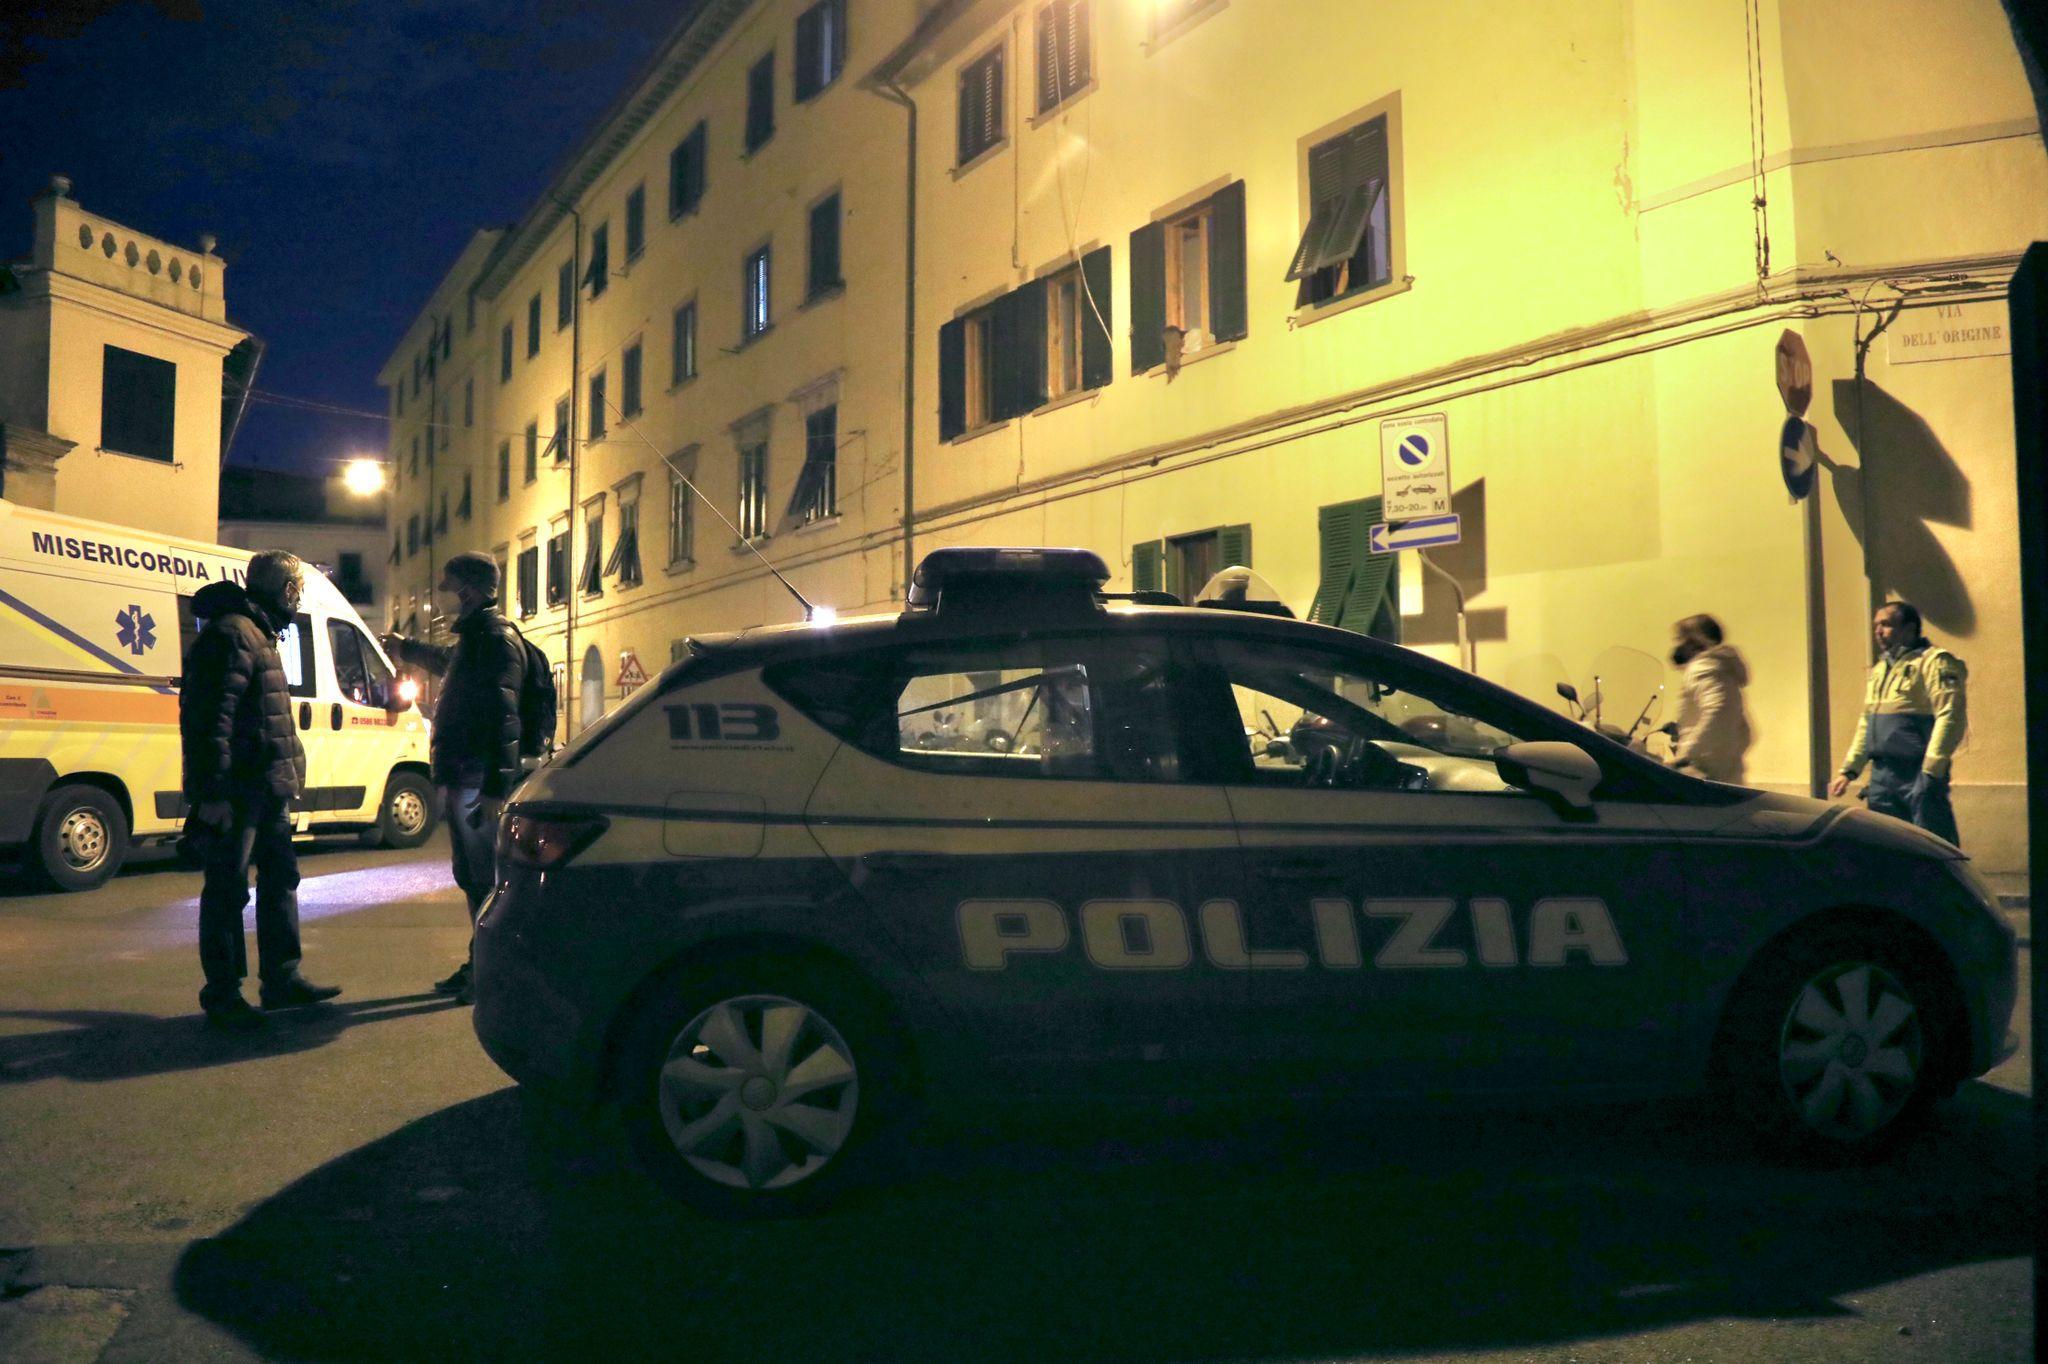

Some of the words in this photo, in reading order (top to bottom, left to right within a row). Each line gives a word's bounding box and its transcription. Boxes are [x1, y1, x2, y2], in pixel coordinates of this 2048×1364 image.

[1936, 304, 1962, 319] VIA
[1433, 499, 1446, 511] M
[32, 531, 210, 581] MISERICORDIA
[662, 703, 780, 741] 113
[956, 898, 1629, 971] POLIZIA
